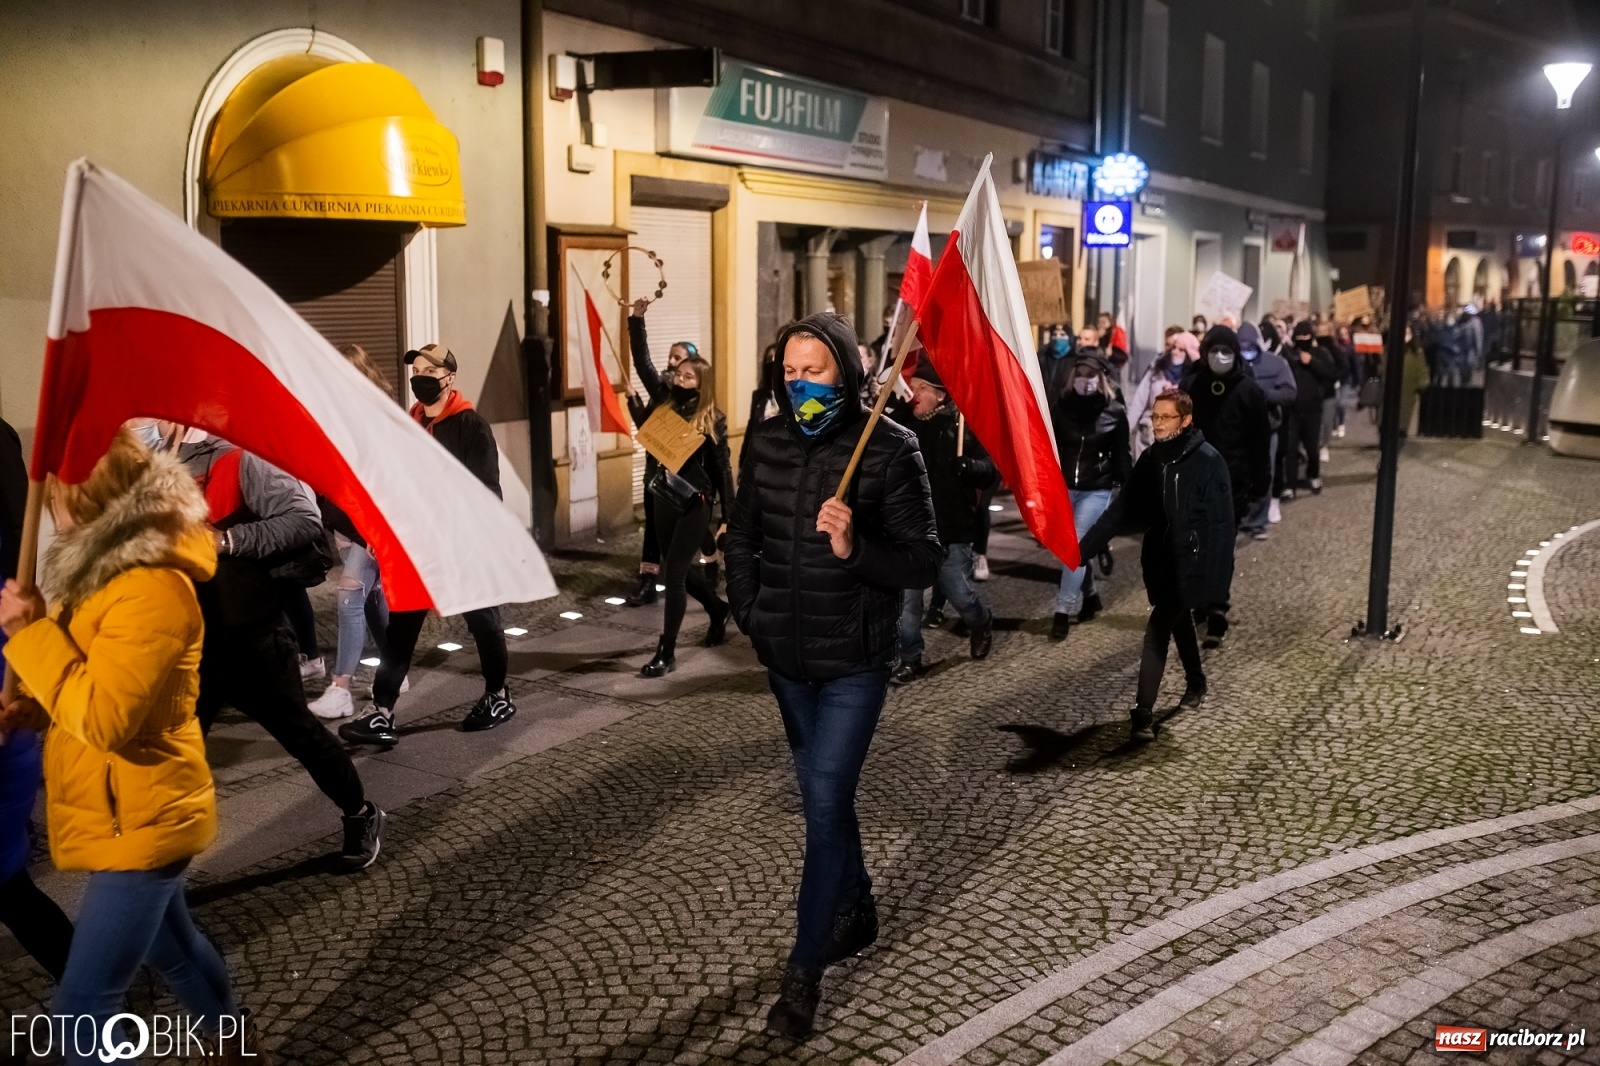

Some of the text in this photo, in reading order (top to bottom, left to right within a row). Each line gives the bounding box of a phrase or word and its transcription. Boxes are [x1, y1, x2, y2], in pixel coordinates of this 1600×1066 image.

[739, 77, 842, 134] FUJIFILM
[213, 200, 279, 212] PIEKARNIA
[282, 200, 361, 213] CUKIERNIA
[365, 202, 427, 216] PIEKARNIA
